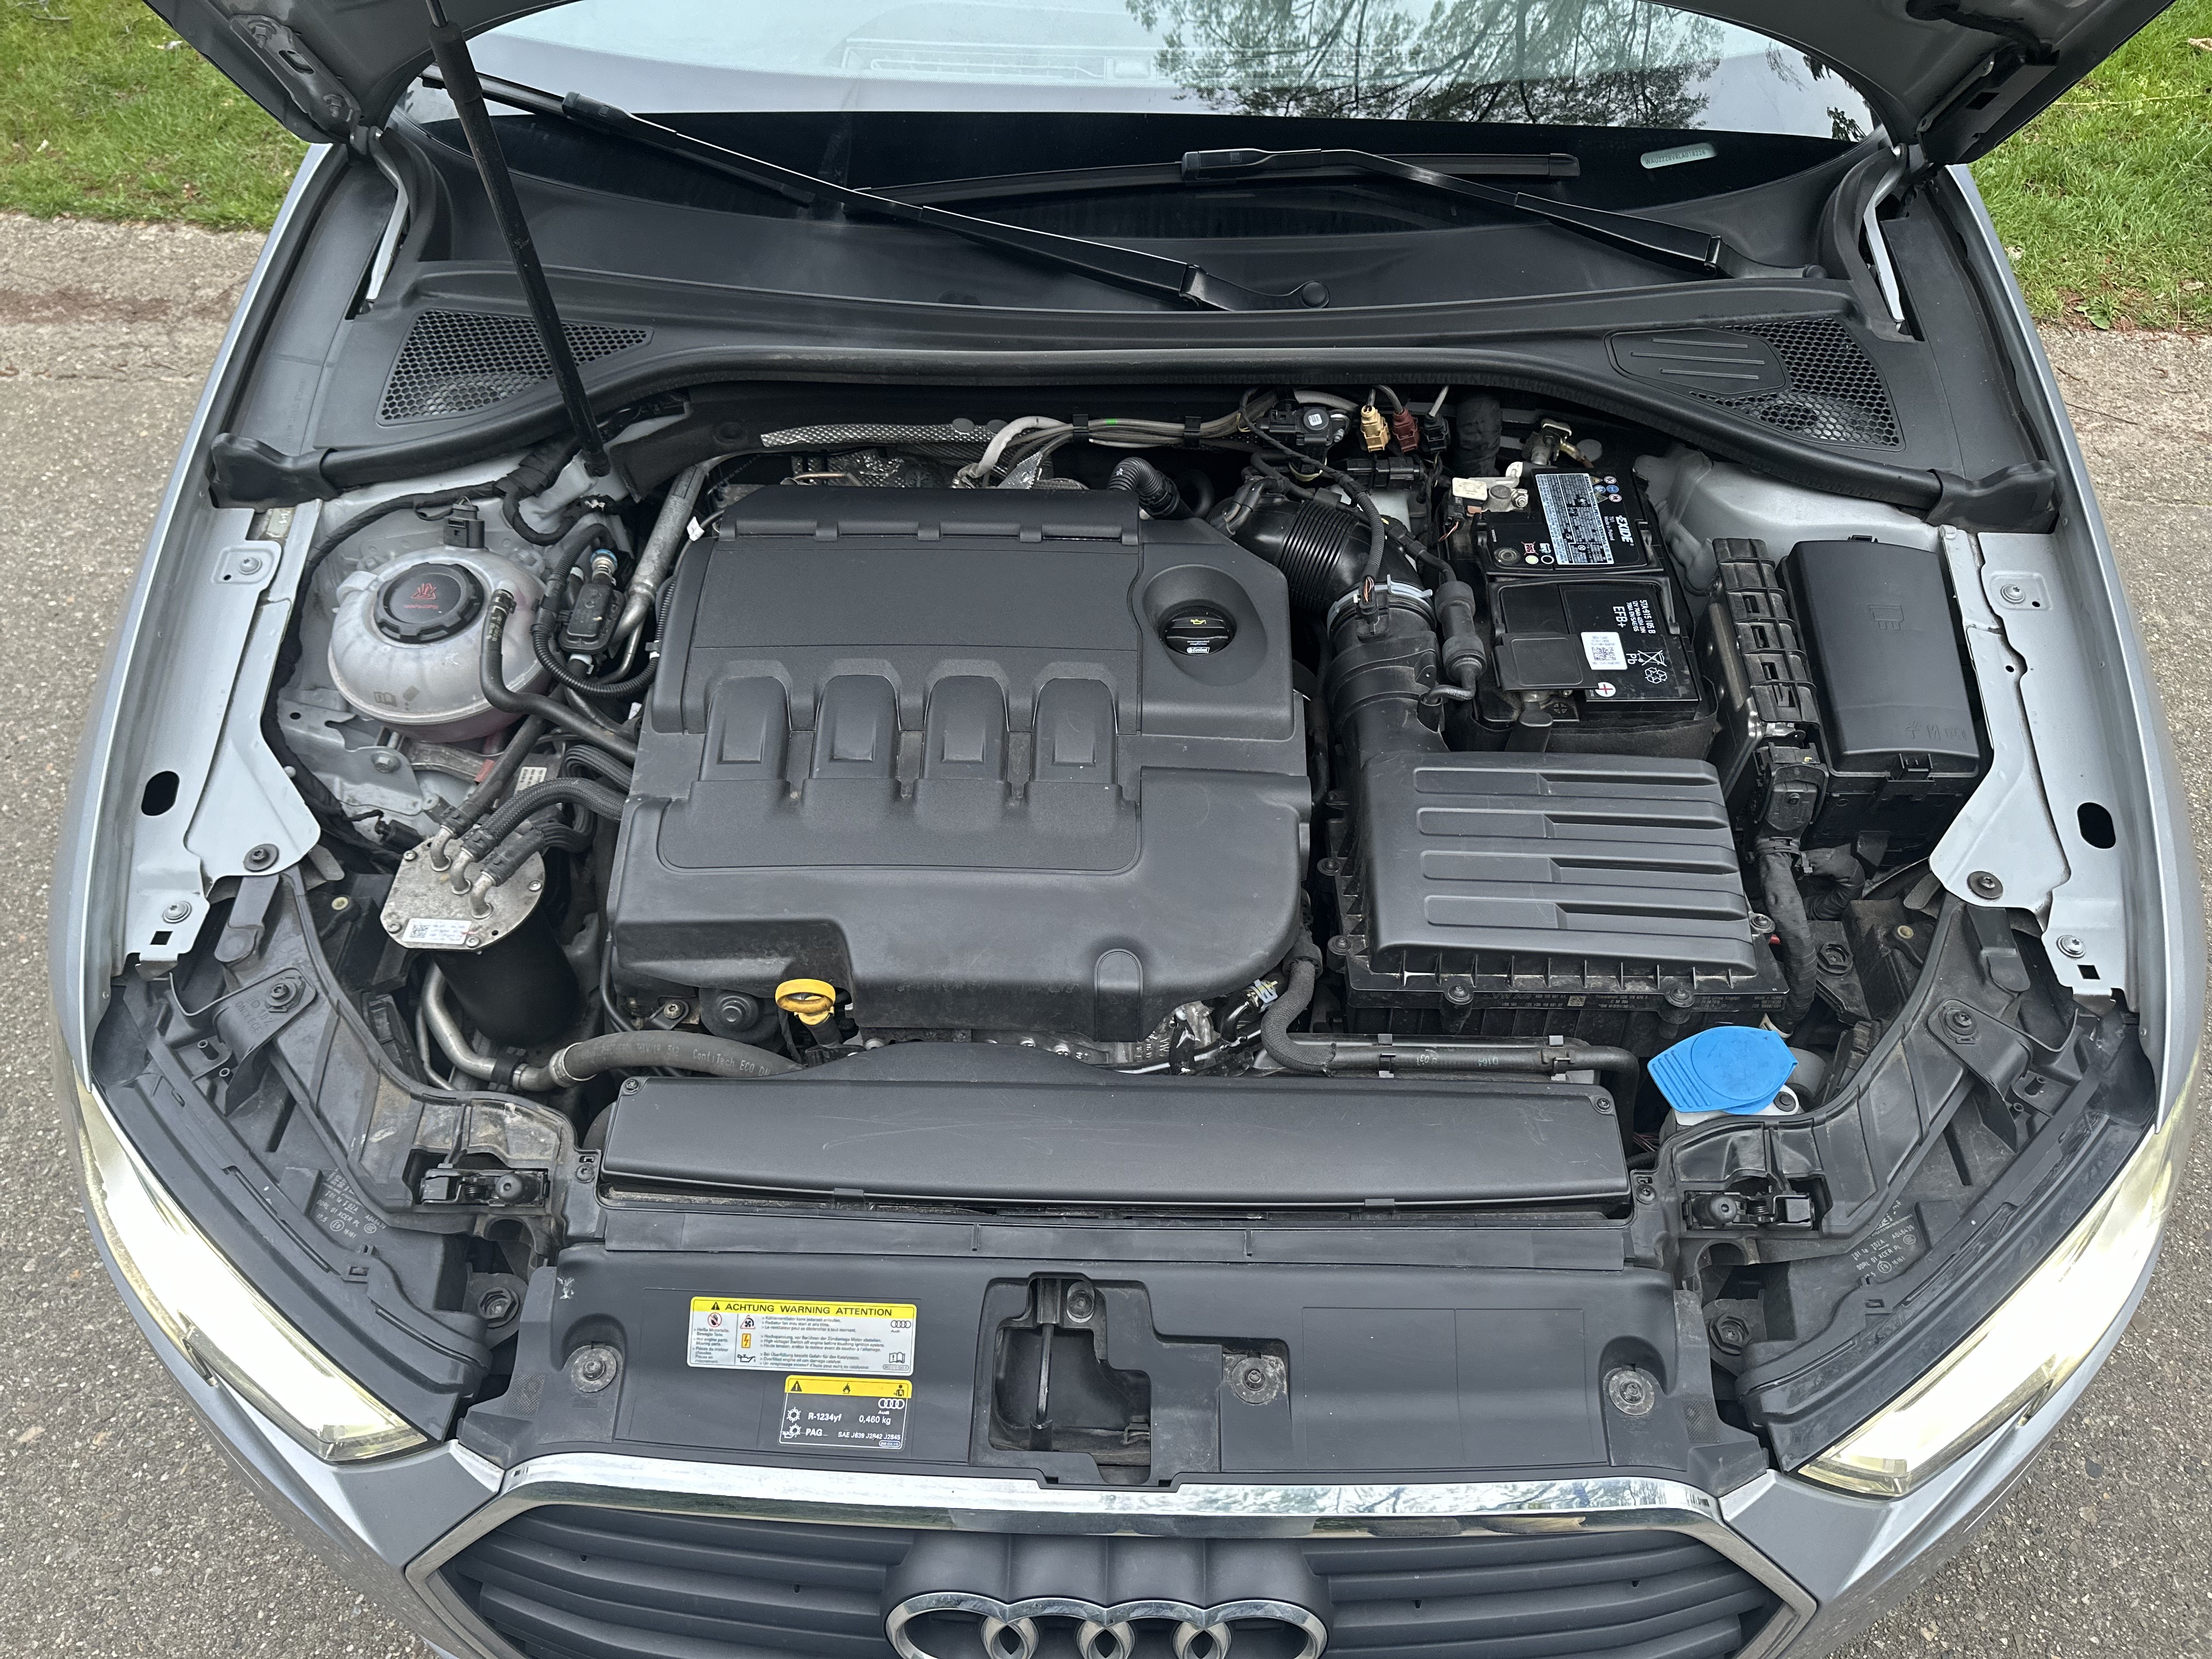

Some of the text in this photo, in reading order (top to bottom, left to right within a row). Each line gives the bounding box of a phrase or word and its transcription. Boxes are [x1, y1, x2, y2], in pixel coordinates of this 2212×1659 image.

[1616, 515, 1634, 543] EXIDE
[1613, 606, 1628, 628] EFB+
[1645, 620, 1655, 629] 105
[1626, 653, 1638, 664] Pb
[693, 1048, 736, 1068] ContiTech
[739, 1059, 755, 1074] ECO
[337, 1211, 353, 1222] XCER
[1878, 1249, 1894, 1259] XCER
[725, 1303, 892, 1316] ACHTUNG WARNING ATTENTION
[808, 1412, 891, 1425] R-1234yf 0,460 kg
